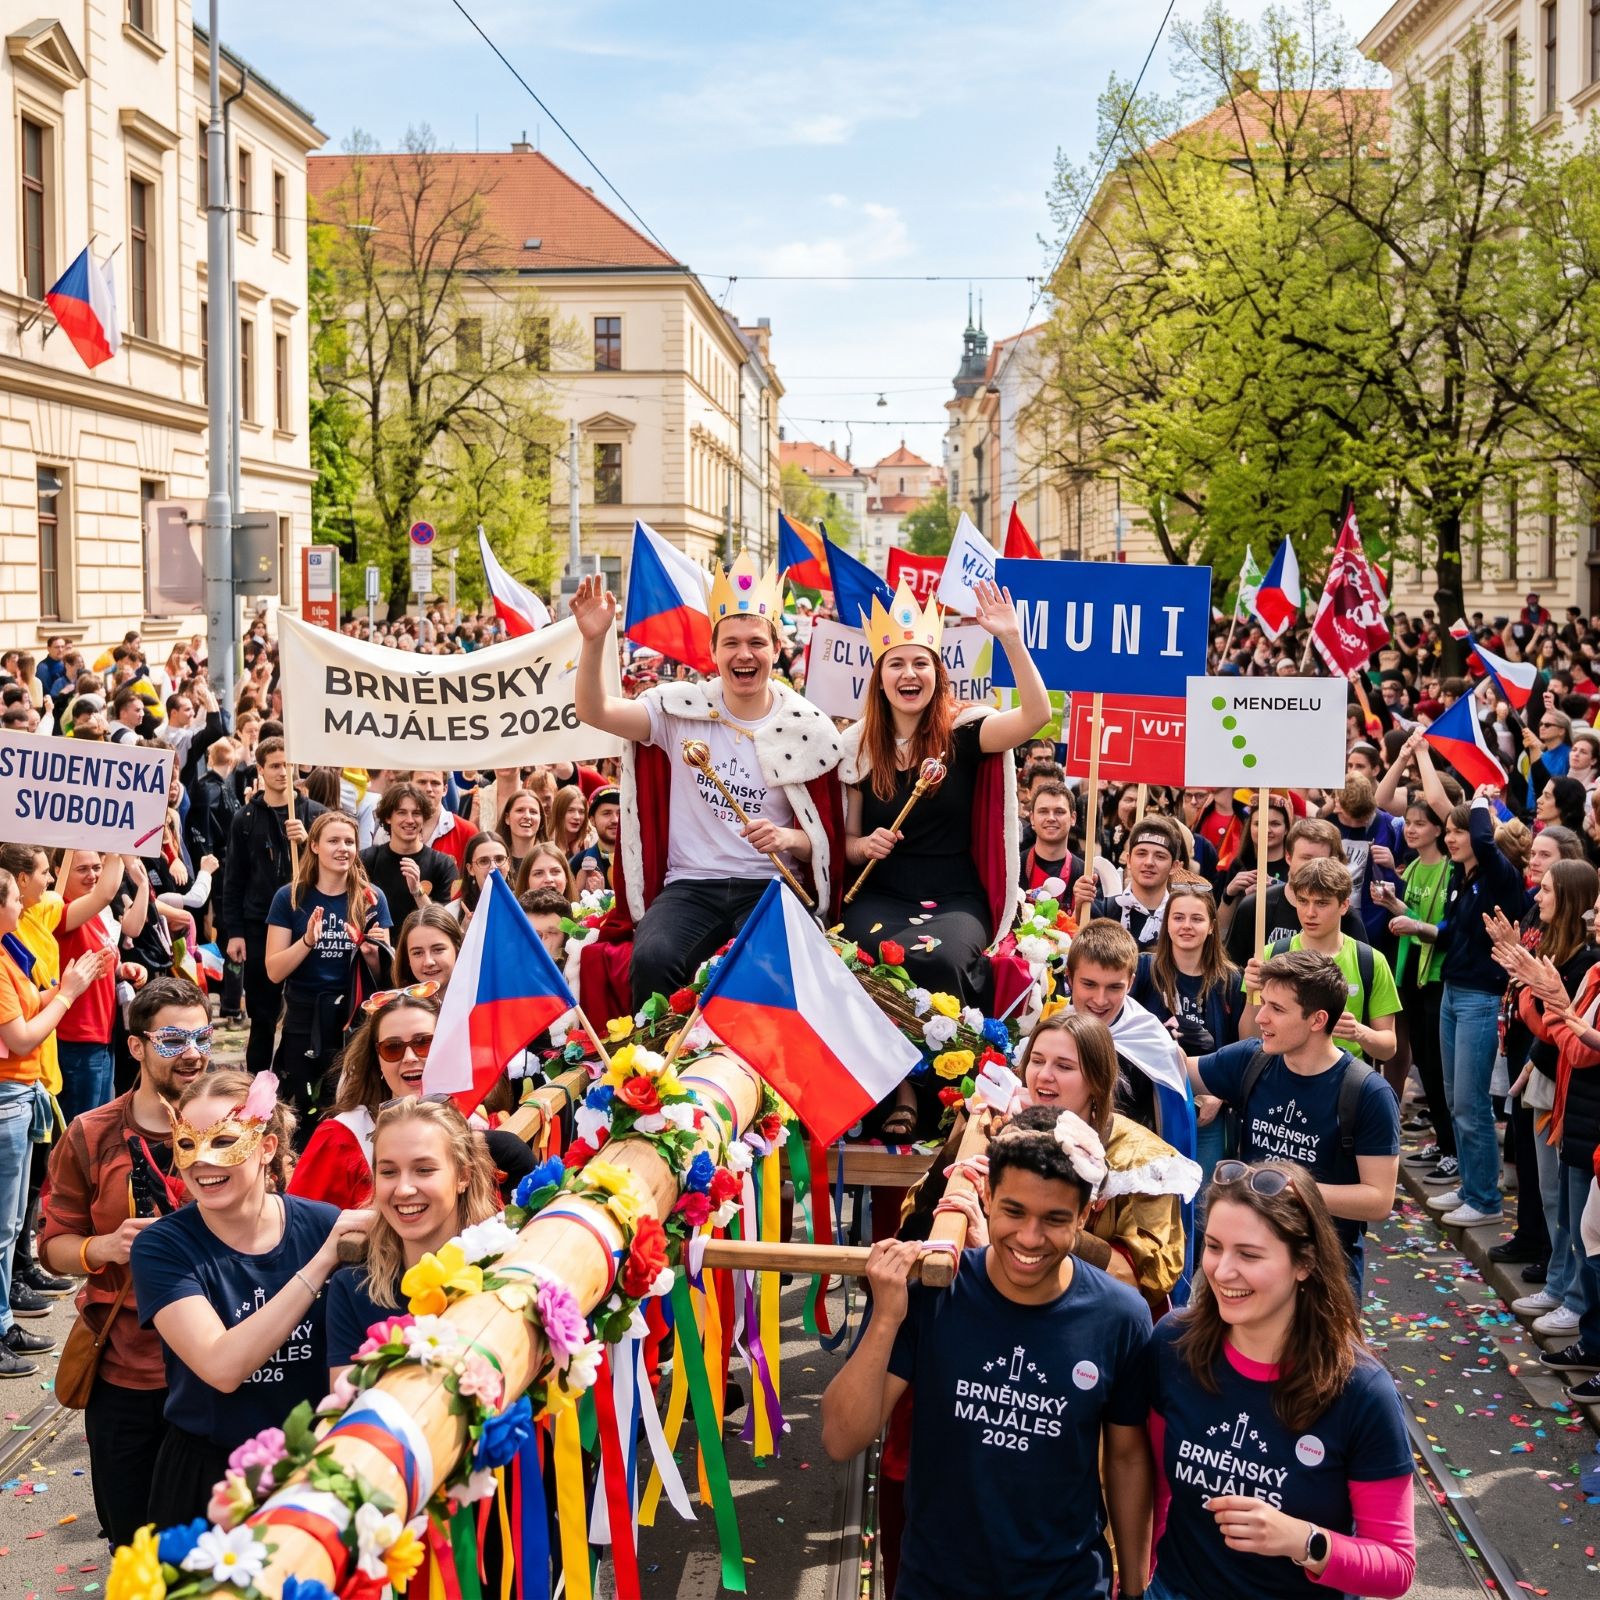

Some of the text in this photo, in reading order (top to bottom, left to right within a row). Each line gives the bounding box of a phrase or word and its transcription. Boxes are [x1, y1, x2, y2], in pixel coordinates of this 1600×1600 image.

[1016, 600, 1185, 656] MUNI
[325, 656, 552, 705] BRNĚNSKÝ
[324, 703, 581, 742] MAJÁLES 2026
[1233, 697, 1321, 711] MENDELU
[1141, 719, 1184, 737] VUT
[0, 747, 165, 795] STUDENTSKÁ
[15, 789, 135, 829] SVOBODA
[1252, 1118, 1320, 1148] BRNĚNSKÝ
[1252, 1132, 1317, 1163] MAJÁLES
[955, 1379, 1068, 1416] BRNĚNSKÝ
[954, 1400, 1062, 1437] MAJÁLES
[981, 1429, 1029, 1451] 2026
[1178, 1439, 1288, 1489] BRNĚNSKÝ
